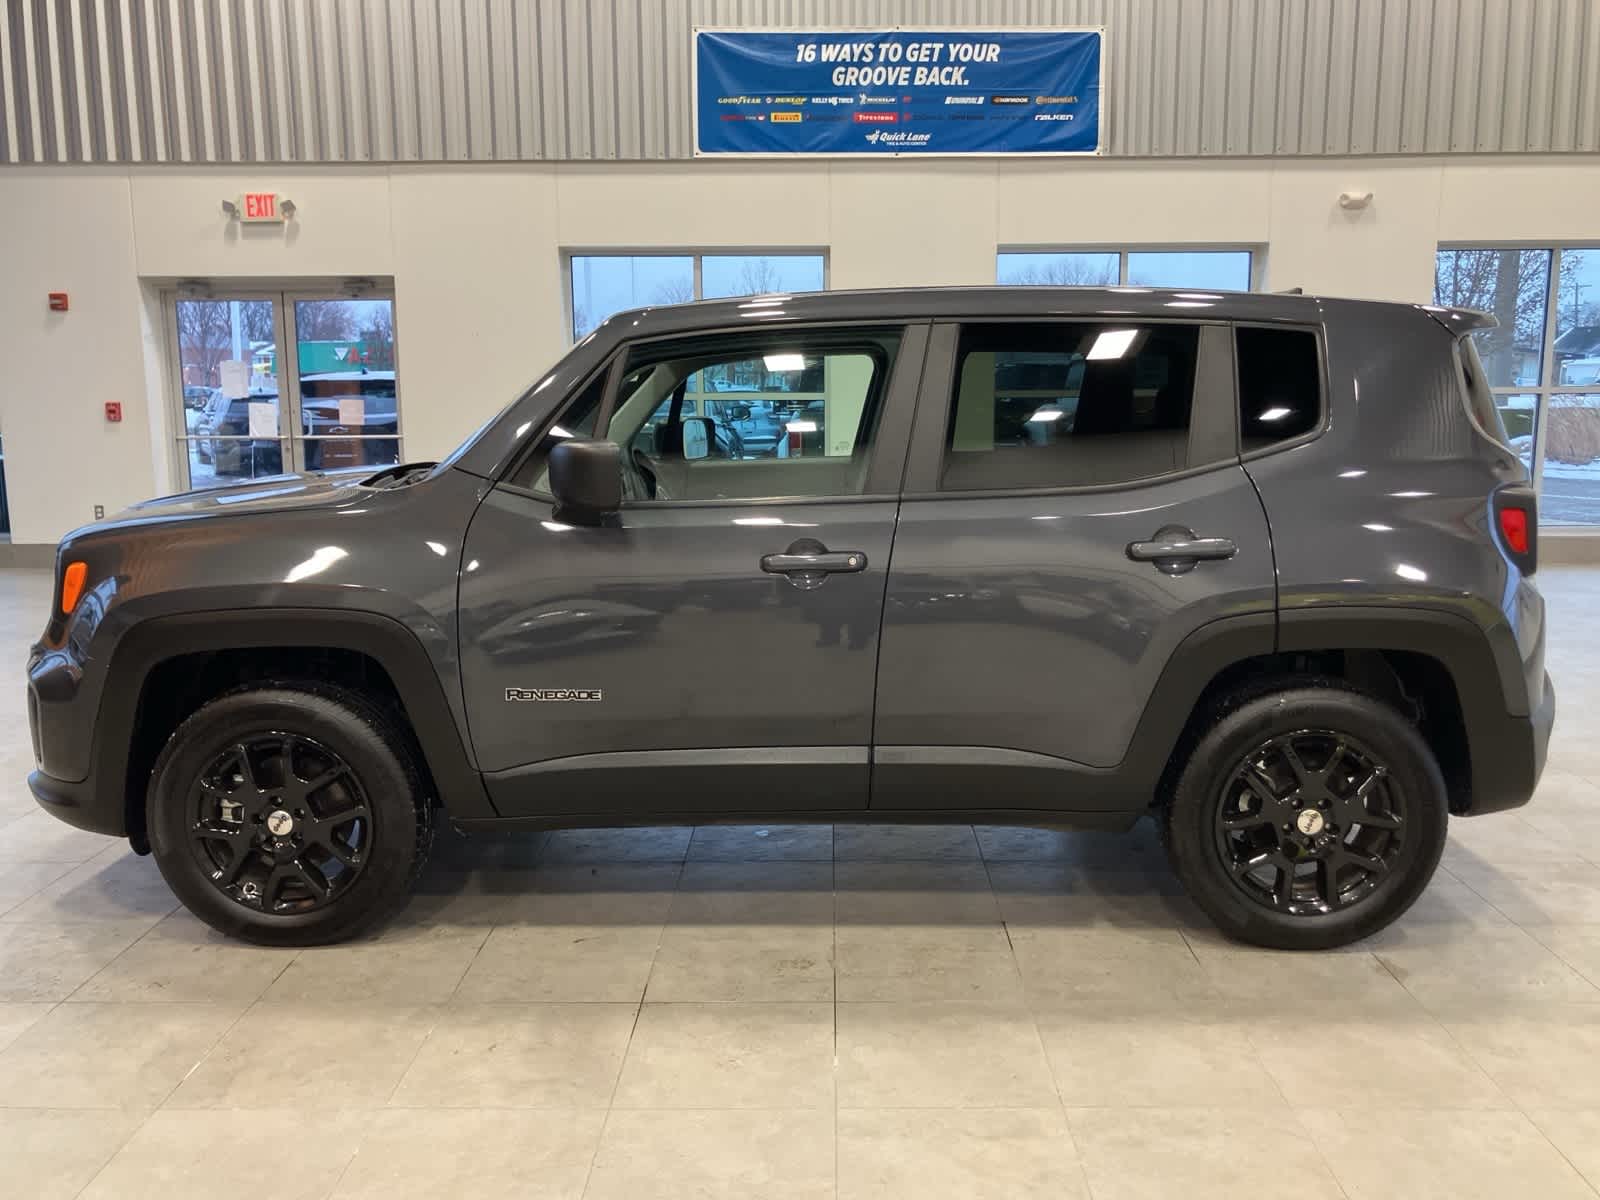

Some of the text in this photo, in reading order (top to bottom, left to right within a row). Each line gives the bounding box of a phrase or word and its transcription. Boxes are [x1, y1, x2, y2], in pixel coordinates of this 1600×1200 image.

[796, 43, 1001, 63] 16 WAYS TO GET YOUR
[832, 66, 969, 86] GROOVE BACK.
[879, 132, 931, 142] Quick Lane
[246, 194, 275, 218] EXIT
[505, 687, 602, 702] RENEGADE
